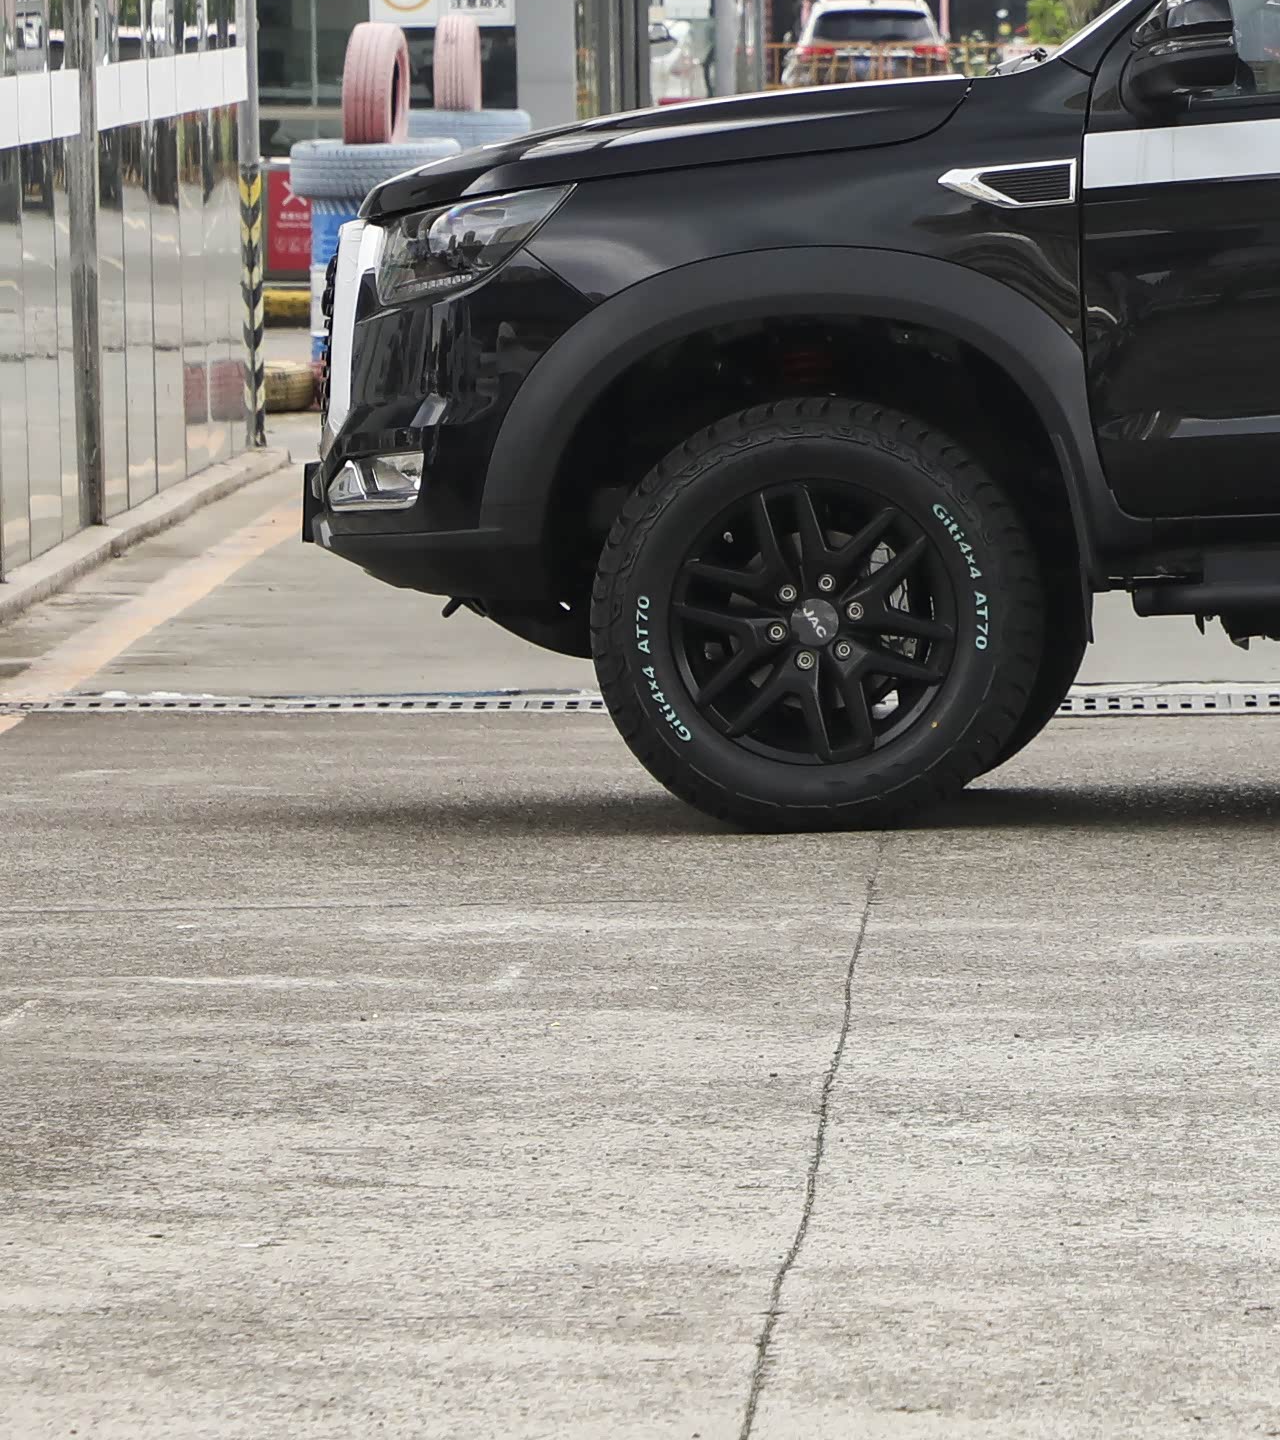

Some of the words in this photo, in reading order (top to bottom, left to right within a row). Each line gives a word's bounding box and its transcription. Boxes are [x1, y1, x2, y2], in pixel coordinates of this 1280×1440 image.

[932, 503, 982, 579] Giti4x4
[974, 590, 989, 650] AT70
[636, 595, 651, 654] AT70
[802, 607, 827, 639] JAC
[642, 665, 692, 742] Giti4x4
